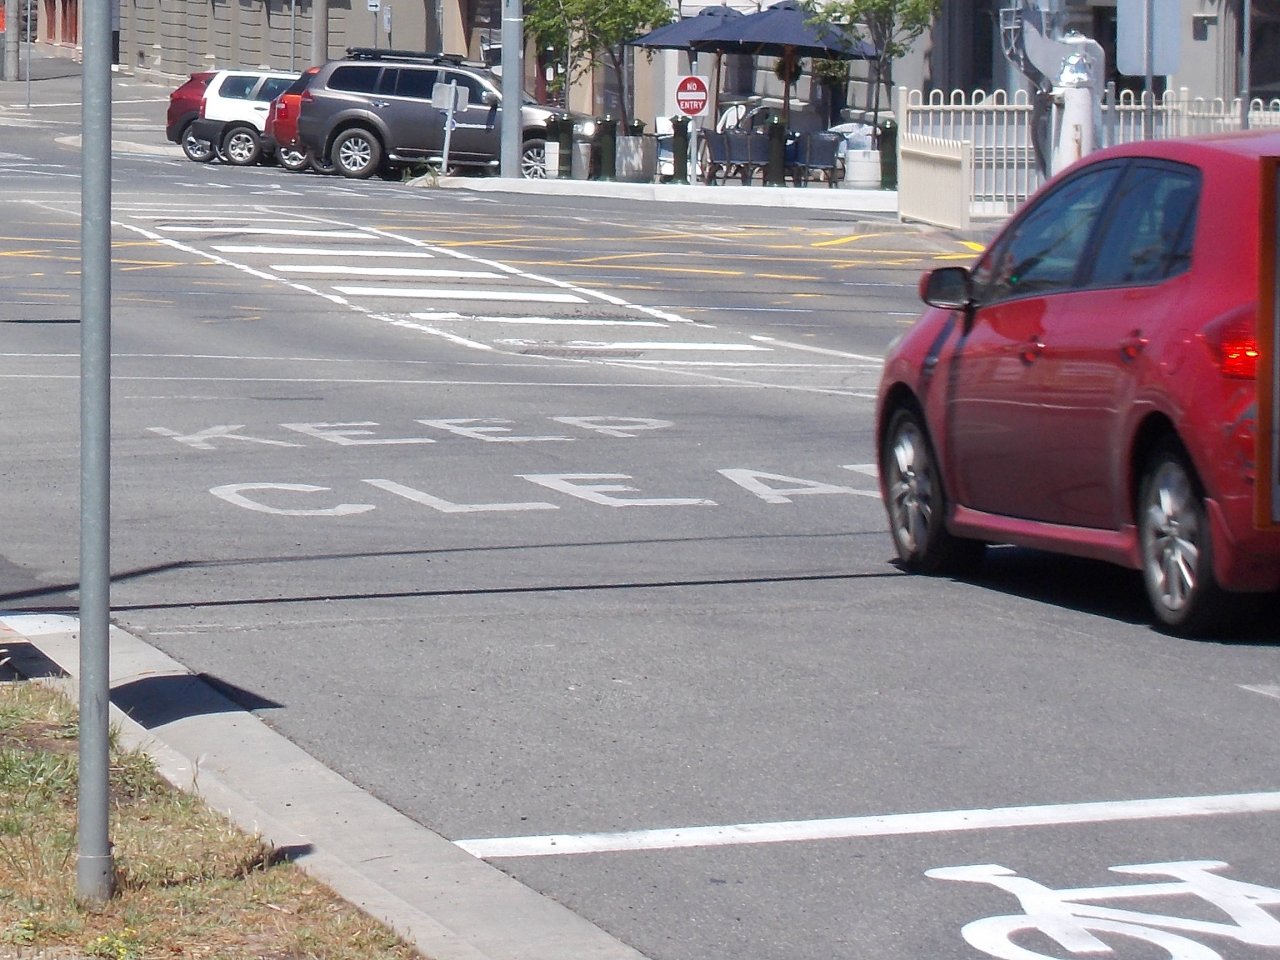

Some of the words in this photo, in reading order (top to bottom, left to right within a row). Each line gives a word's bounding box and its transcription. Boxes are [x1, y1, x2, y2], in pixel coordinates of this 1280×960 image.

[687, 82, 697, 90] NO
[680, 101, 704, 110] ENTRY
[146, 416, 674, 449] KEEP
